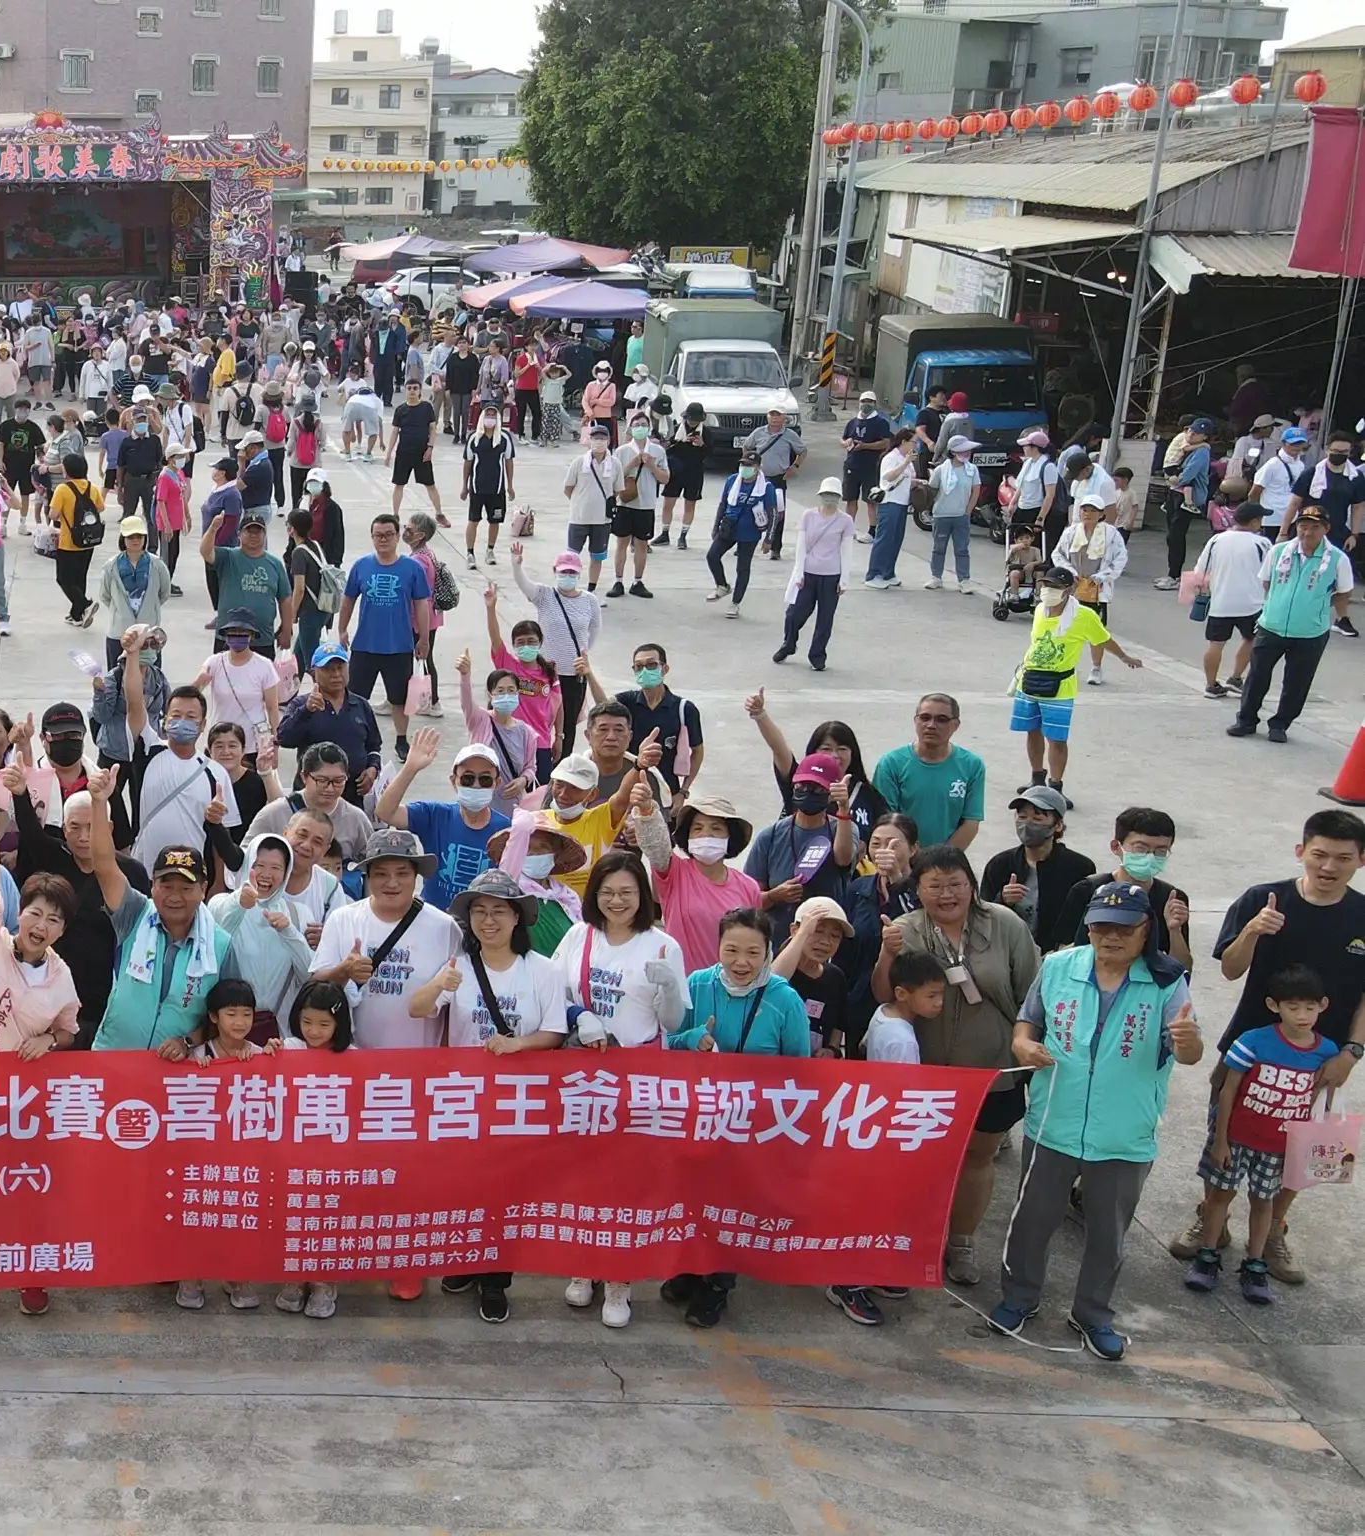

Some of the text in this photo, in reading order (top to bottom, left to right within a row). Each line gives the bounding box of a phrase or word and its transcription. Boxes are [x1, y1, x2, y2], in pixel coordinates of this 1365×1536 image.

[367, 946, 410, 963] NON
[374, 964, 414, 980] IGHT
[590, 967, 623, 987] EON
[369, 978, 403, 996] RUN
[477, 993, 517, 1011] NON
[591, 1001, 614, 1018] UN
[1257, 1064, 1314, 1092] BES
[1247, 1082, 1282, 1104] POP
[114, 1107, 151, 1142] 暨
[161, 1069, 957, 1152] 喜樹萬皇宮王爺聖誕文化季
[286, 1167, 397, 1186] 臺南市市議會
[286, 1192, 341, 1209] 萬皇宮
[284, 1246, 499, 1272] 臺南市政府警察局第六分局
